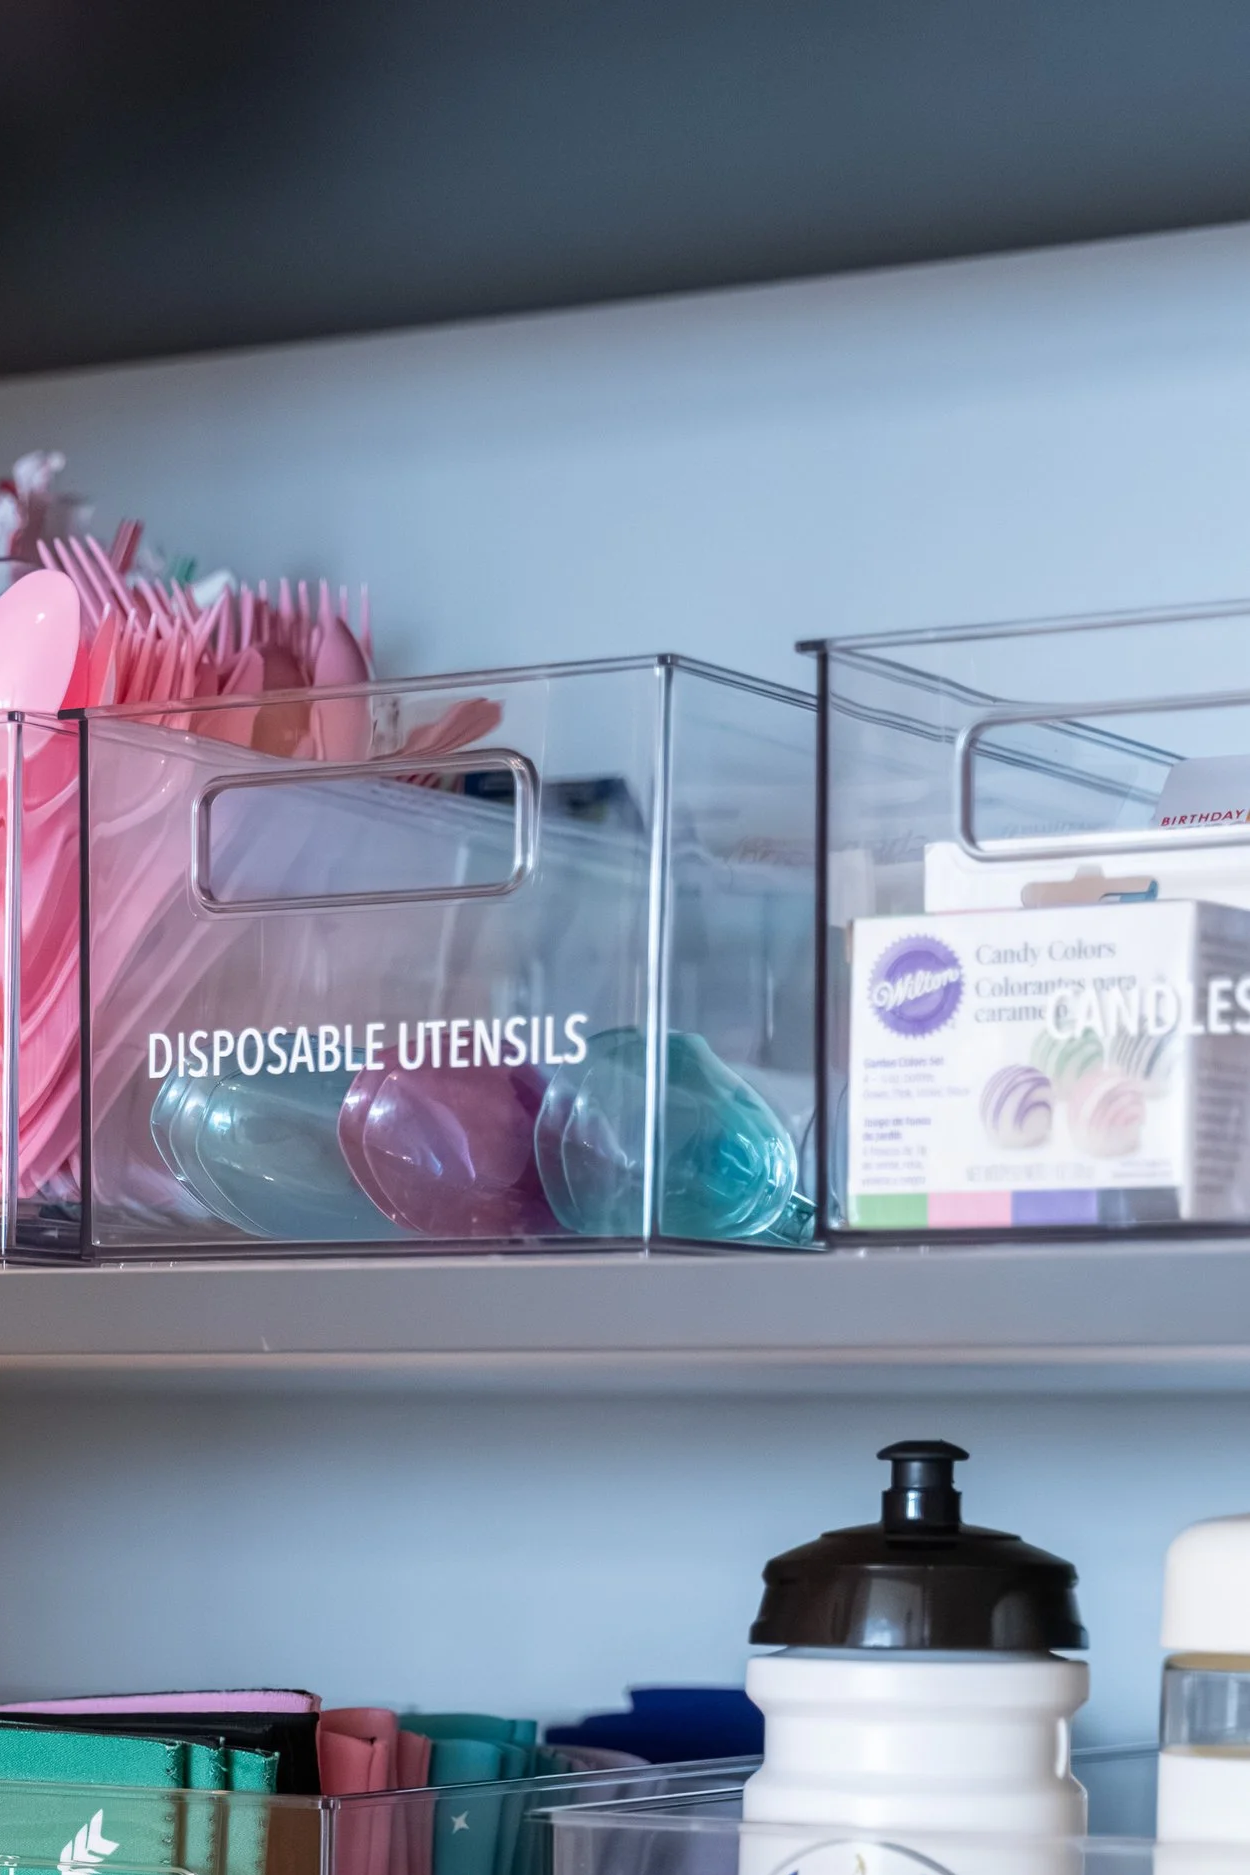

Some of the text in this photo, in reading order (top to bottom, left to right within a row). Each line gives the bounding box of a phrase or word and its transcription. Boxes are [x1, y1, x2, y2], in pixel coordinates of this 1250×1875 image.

[1160, 808, 1246, 827] BIRTHDAY
[974, 938, 1118, 968] Candy Colors
[873, 968, 960, 1012] Wilton
[1049, 977, 1250, 1040] CANDLES
[150, 1013, 588, 1079] DISPOSABLE UTENSILS
